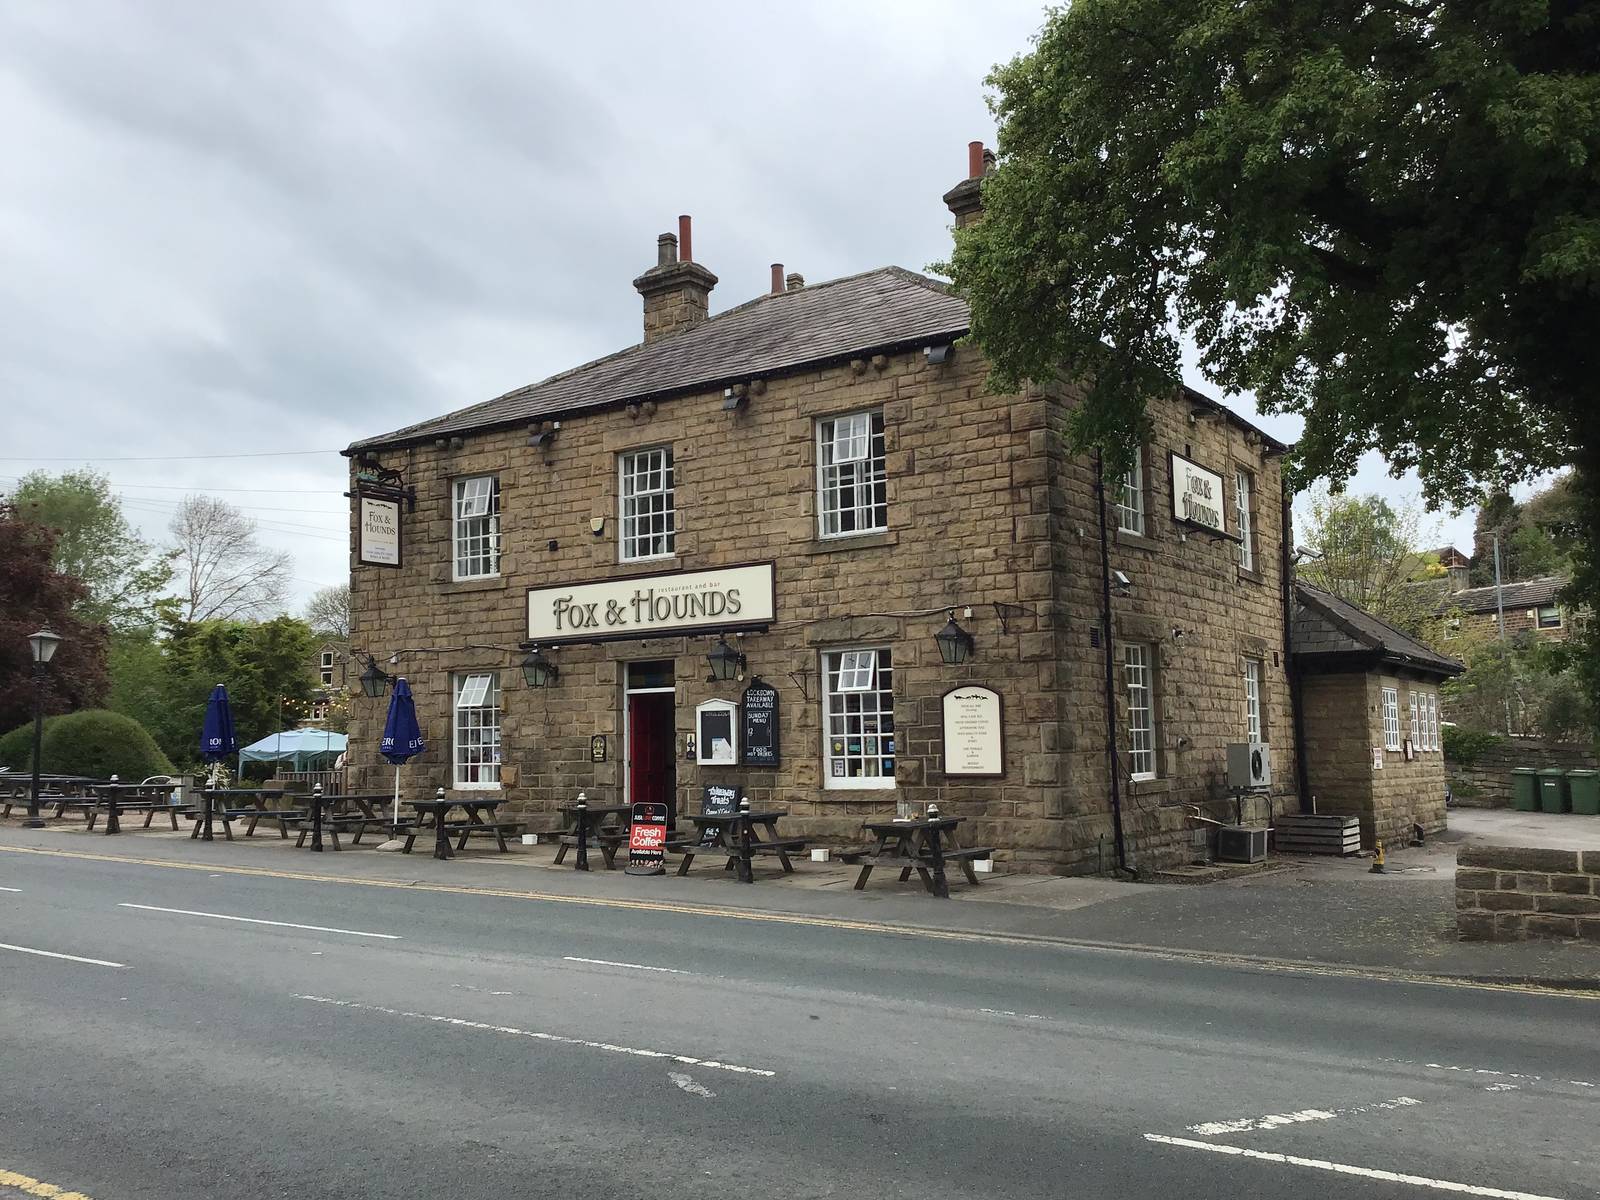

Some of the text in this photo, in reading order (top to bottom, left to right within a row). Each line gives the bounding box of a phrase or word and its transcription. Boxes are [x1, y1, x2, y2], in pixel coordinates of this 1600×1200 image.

[1204, 480, 1212, 500] &
[658, 584, 692, 593] restaurant
[695, 582, 707, 590] and
[553, 588, 742, 630] FOX & HOUNDS
[635, 827, 661, 837] Fresh
[632, 836, 662, 847] Coffee
